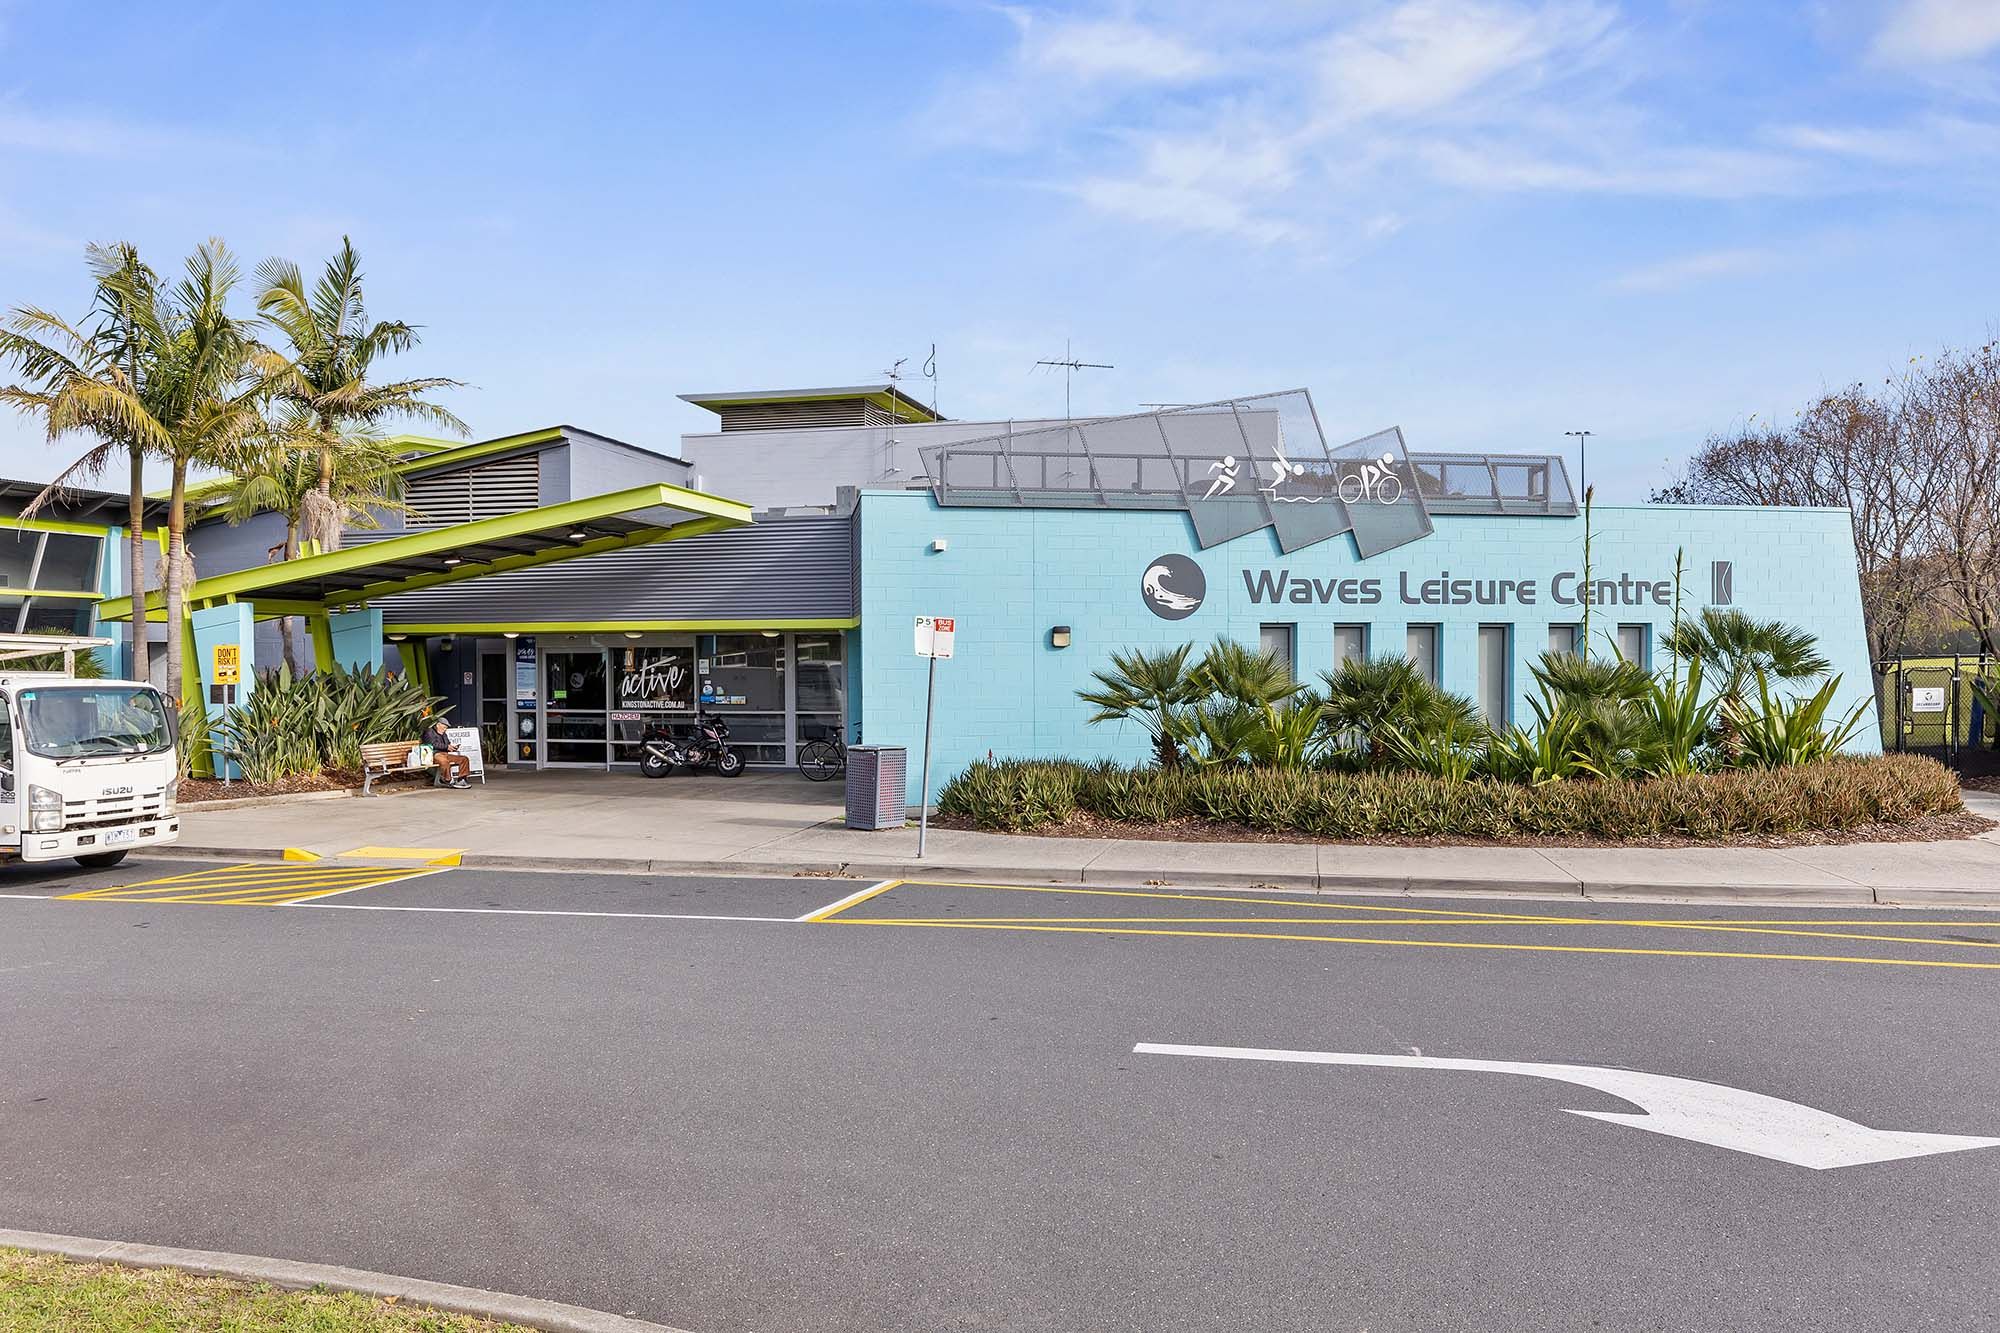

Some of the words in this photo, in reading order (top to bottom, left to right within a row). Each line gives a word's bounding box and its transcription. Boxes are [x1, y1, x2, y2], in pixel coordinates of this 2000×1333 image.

[1242, 569, 1382, 604] Waves
[1399, 571, 1536, 605] Leisure
[1551, 572, 1671, 606] Centre
[916, 617, 924, 627] P
[217, 648, 236, 657] DON'T
[231, 657, 237, 665] IT
[622, 656, 685, 698] active
[622, 700, 685, 709] KINGSTONACTIVE.COM.AU
[102, 786, 134, 796] ISUZU
